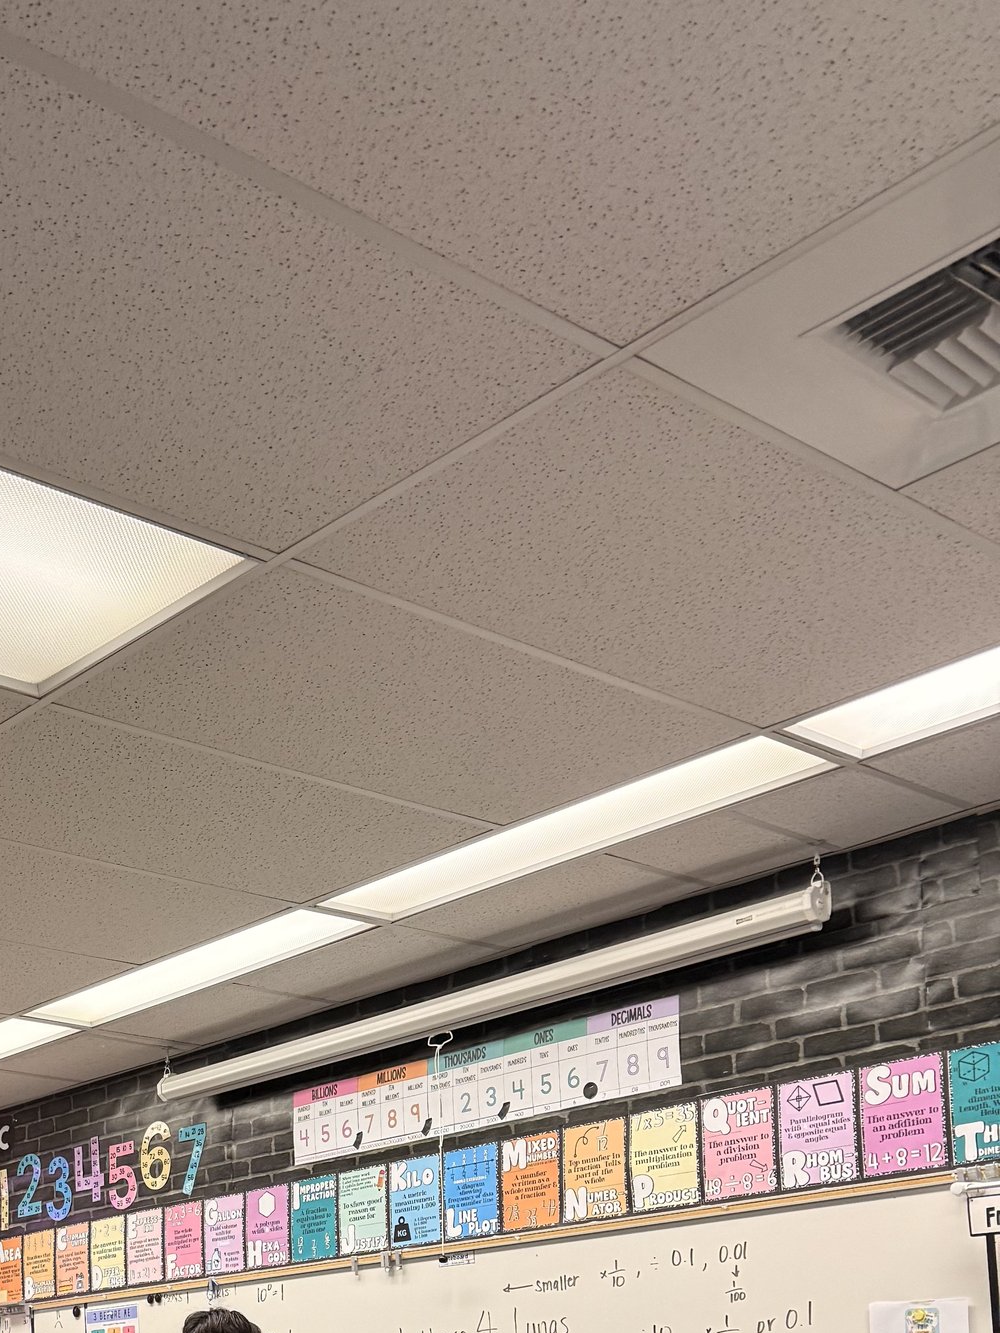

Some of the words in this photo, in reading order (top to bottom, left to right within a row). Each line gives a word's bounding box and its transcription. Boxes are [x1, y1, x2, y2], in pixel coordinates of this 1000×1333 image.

[611, 1004, 652, 1027] DECIMALS
[534, 1029, 554, 1045] ONES
[443, 1046, 487, 1068] THOUSANDS
[376, 1067, 406, 1085] MILLIONS
[311, 1084, 338, 1100] BILLIONS
[864, 1065, 936, 1105] SUM
[299, 1128, 310, 1147] 4
[321, 1124, 331, 1143] 5
[341, 1119, 353, 1138] 6
[364, 1114, 375, 1133] 7
[387, 1109, 398, 1128] 8
[410, 1103, 420, 1123] 9
[460, 1092, 472, 1113] 2
[485, 1086, 496, 1107] 3
[512, 1079, 525, 1100] 4
[540, 1073, 551, 1095] 5
[567, 1067, 580, 1089] 6
[596, 1059, 609, 1083] 7
[627, 1053, 639, 1076] 8
[657, 1046, 670, 1069] 9
[736, 1109, 770, 1128] IENT
[789, 1111, 844, 1126] Parallelogram
[866, 1114, 885, 1125] The
[886, 1108, 927, 1122] answer
[809, 1119, 831, 1131] equal
[872, 1124, 886, 1133] an
[888, 1117, 932, 1130] addition
[708, 1140, 723, 1149] The
[724, 1136, 758, 1147] answer
[804, 1134, 829, 1144] angles
[879, 1128, 925, 1143] problem
[502, 1137, 557, 1172] MIXED
[649, 1145, 679, 1156] answer
[722, 1142, 760, 1155] division
[868, 1152, 879, 1169] 4
[895, 1148, 908, 1166] 8
[924, 1143, 943, 1163] 12
[527, 1152, 557, 1163] NUMBER
[580, 1155, 610, 1165] number
[635, 1151, 693, 1166] multiplication
[719, 1152, 757, 1166] problem
[17, 1153, 42, 1218] 2
[46, 1156, 73, 1221] 3
[74, 1136, 104, 1202] 4
[108, 1140, 138, 1210] 5
[140, 1121, 171, 1190] 6
[178, 1122, 207, 1195] 7
[574, 1163, 601, 1173] fraction
[647, 1160, 680, 1172] problem
[819, 1162, 853, 1181] BUS
[390, 1161, 434, 1193] KILO
[511, 1178, 536, 1187] written
[520, 1170, 547, 1180] number
[584, 1176, 606, 1185] whole
[741, 1173, 753, 1191] 8
[302, 1190, 335, 1202] FRACTION
[407, 1190, 427, 1199] metric
[504, 1186, 524, 1195] whole
[525, 1183, 552, 1193] number
[520, 1190, 546, 1200] fraction
[632, 1175, 698, 1209] PRODUCT
[395, 1196, 435, 1207] measurement
[591, 1201, 622, 1216] ATOR
[205, 1199, 243, 1226] GALLON
[348, 1207, 368, 1216] reason
[394, 1205, 421, 1214] meaning
[445, 1208, 478, 1237] LINE
[469, 1219, 498, 1235] PLOT
[342, 1224, 387, 1253] JUSTIFY
[267, 1251, 286, 1264] GON
[612, 1275, 625, 1288] 10
[671, 1248, 694, 1267] 0.1
[719, 1241, 748, 1263] 0.01
[166, 1254, 200, 1279] FACTOR
[535, 1274, 579, 1293] smaller
[730, 1291, 747, 1303] 100
[757, 1317, 776, 1333] or
[785, 1301, 813, 1330] 0.1
